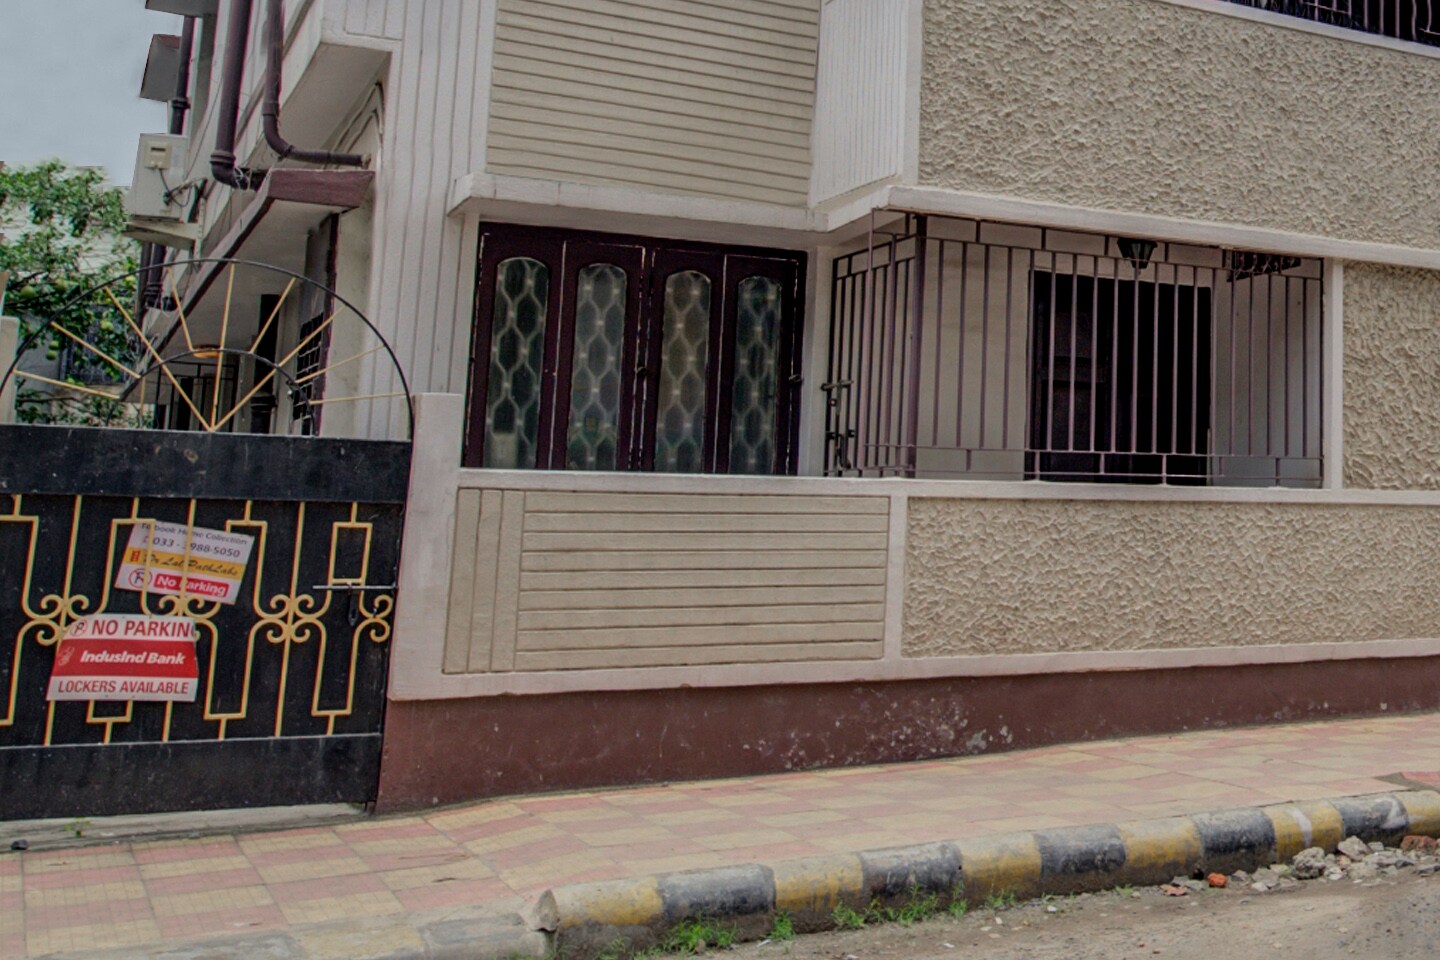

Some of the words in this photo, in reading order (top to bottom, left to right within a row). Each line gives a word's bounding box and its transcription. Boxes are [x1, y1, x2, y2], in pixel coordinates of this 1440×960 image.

[205, 533, 248, 545] Collection
[157, 577, 177, 587] No
[179, 579, 226, 596] arking
[91, 619, 118, 636] NO
[124, 620, 196, 638] PARKIN
[80, 650, 148, 664] IndusInd
[147, 652, 186, 665] Bank
[58, 680, 117, 693] LOCKERS
[119, 681, 189, 695] AVAILABLE
